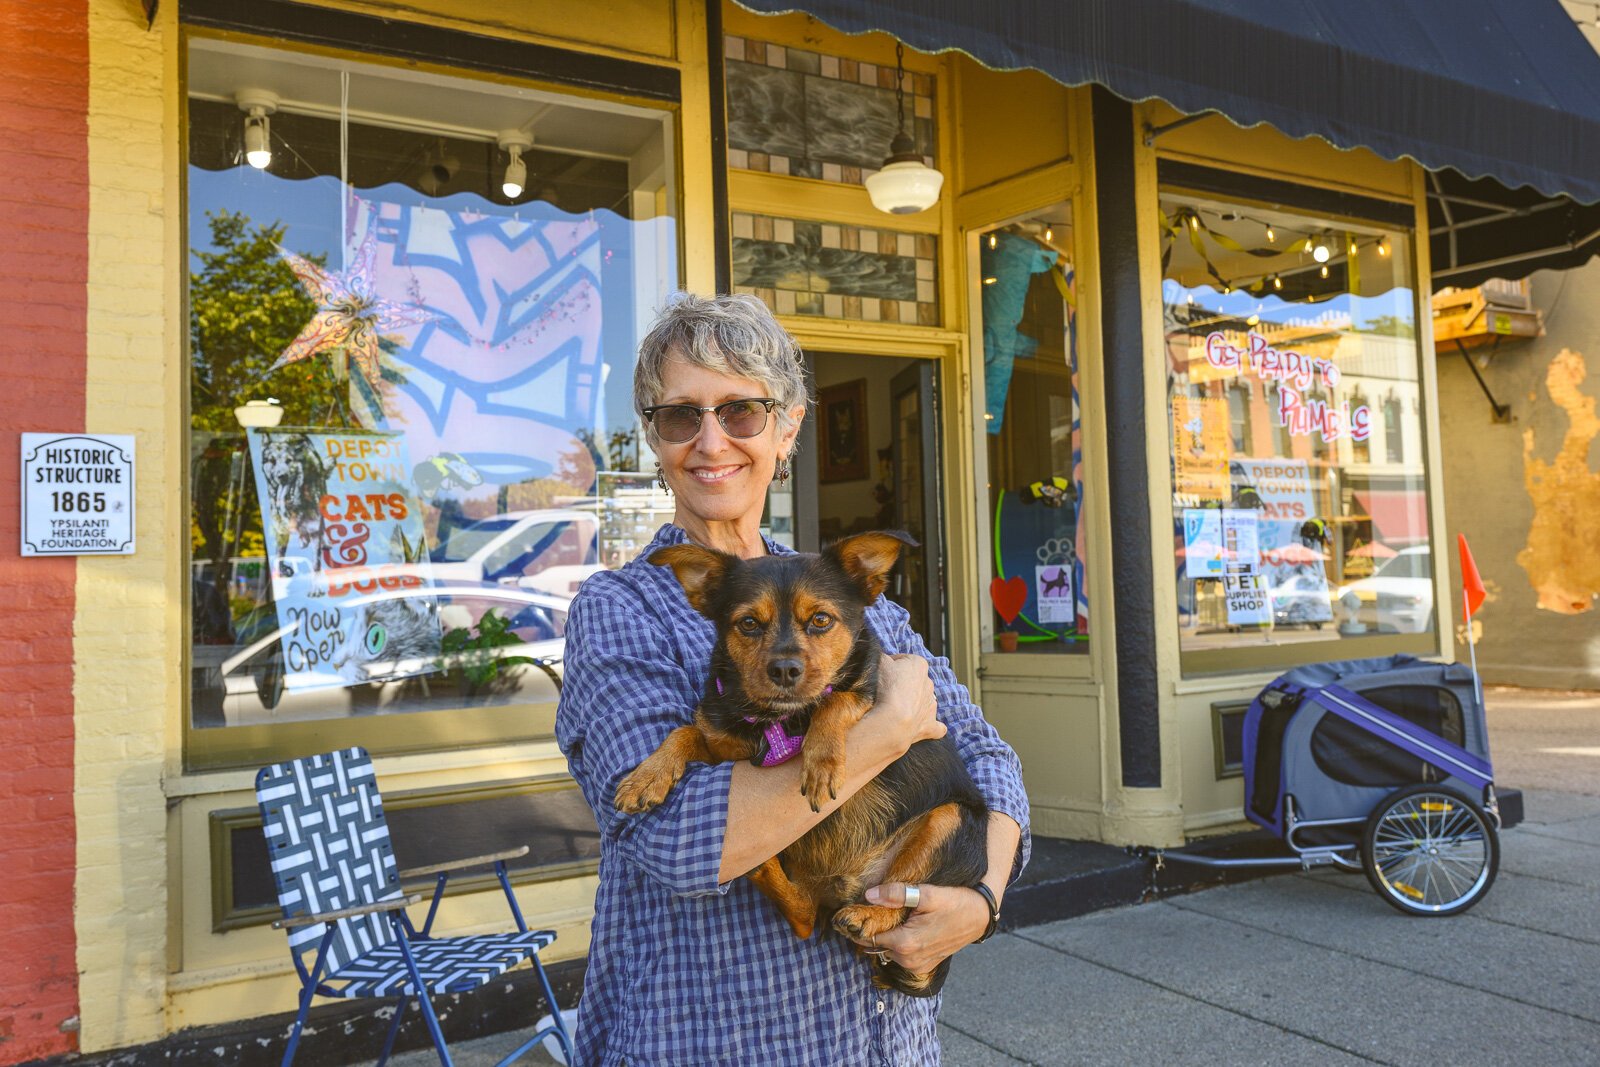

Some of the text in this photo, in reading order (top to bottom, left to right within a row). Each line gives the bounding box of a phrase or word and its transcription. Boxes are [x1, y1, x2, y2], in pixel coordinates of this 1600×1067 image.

[1315, 360, 1340, 386] TO
[46, 448, 115, 465] HISTORIC
[325, 438, 402, 459] DEPOT
[35, 467, 122, 484] STRUCTURE
[335, 462, 407, 482] TOWN
[1251, 465, 1305, 479] DEPOT
[1257, 481, 1307, 495] TOWN
[51, 491, 106, 513] 1865
[319, 492, 409, 522] CATS
[1258, 502, 1306, 519] ATS
[50, 519, 110, 528] YPSILANTI
[52, 529, 106, 538] HERITAGE
[41, 538, 117, 549] FOUNDATION
[323, 522, 371, 569] &
[324, 563, 422, 598] DOGS
[1225, 575, 1262, 590] PET
[1226, 590, 1268, 600] UPPLIES
[1230, 600, 1265, 611] SHOP
[286, 607, 341, 646] Now
[288, 629, 346, 672] Open
